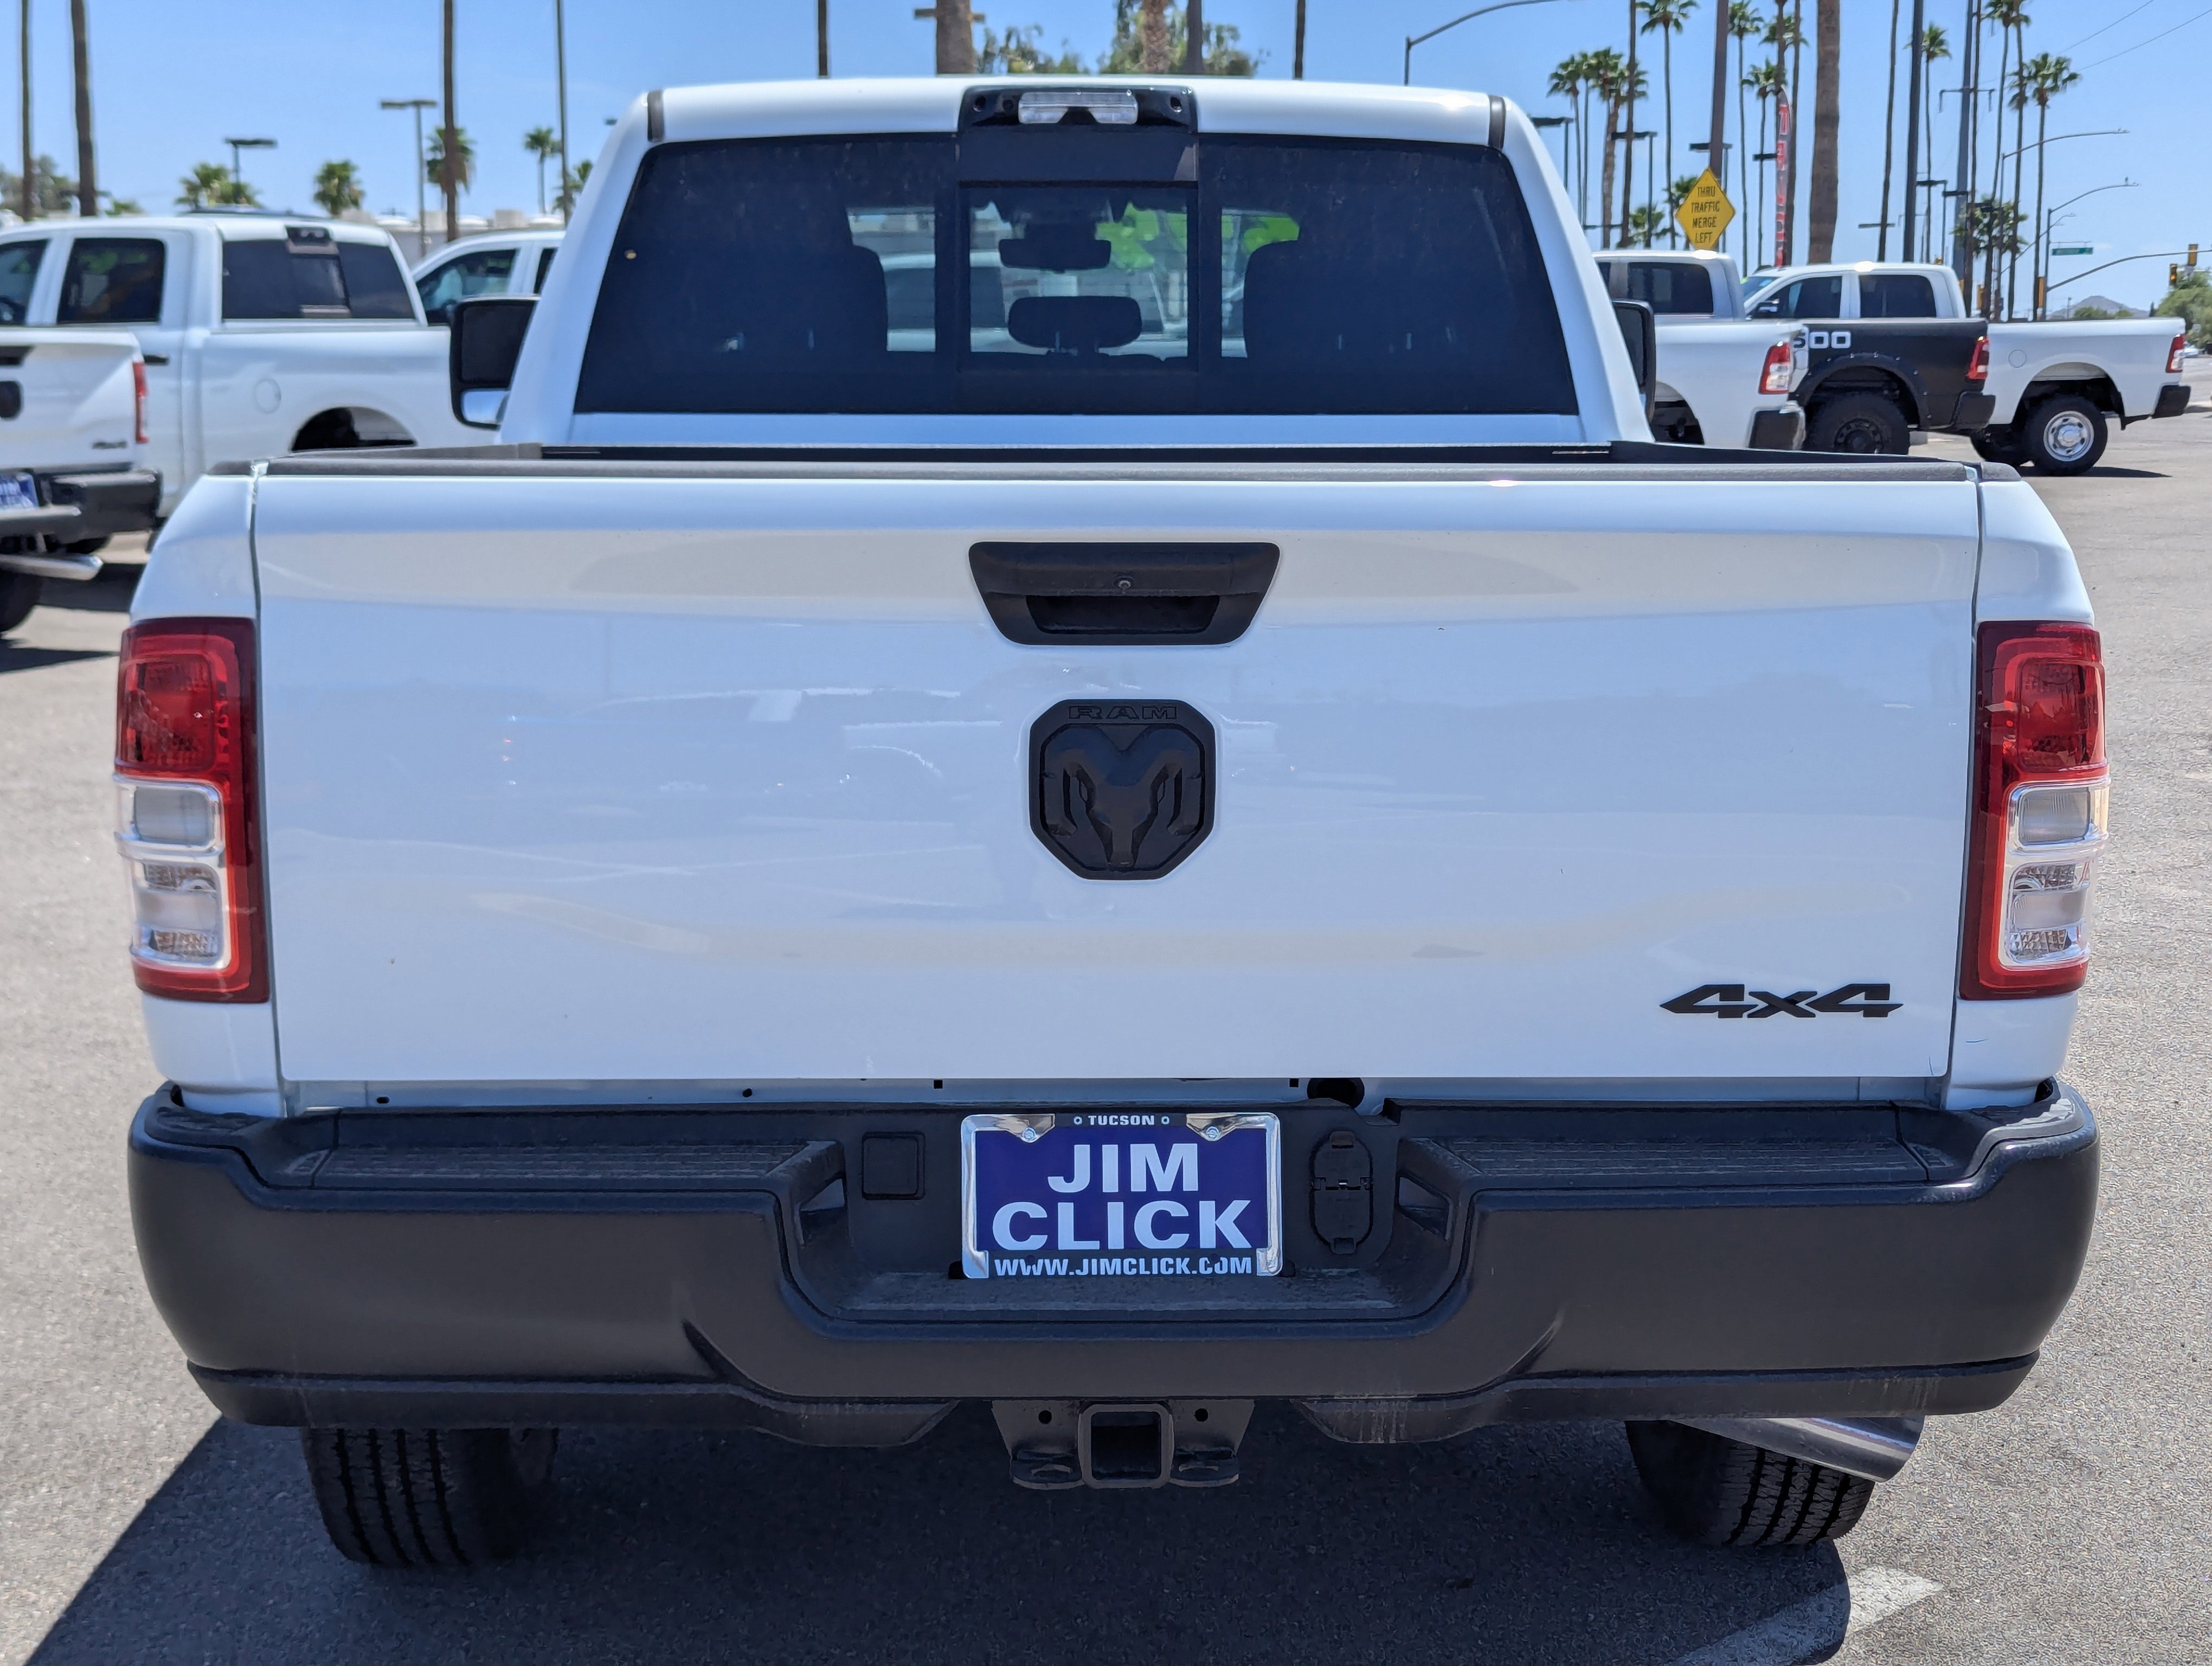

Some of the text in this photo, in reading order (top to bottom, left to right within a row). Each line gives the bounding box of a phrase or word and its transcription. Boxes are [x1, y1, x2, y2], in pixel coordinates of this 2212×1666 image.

[1697, 186, 1716, 197] THRU
[1691, 201, 1721, 214] TRAFFIC
[1693, 217, 1718, 228] MERGE
[1695, 232, 1713, 244] LEFT
[1068, 706, 1178, 720] RAM
[1660, 984, 1904, 1018] 4x4
[1088, 1114, 1155, 1126] TUCSON
[1047, 1143, 1199, 1193] JIM
[992, 1200, 1252, 1251] CLICK
[994, 1257, 1252, 1277] WWW.JIMCLICK.COM
